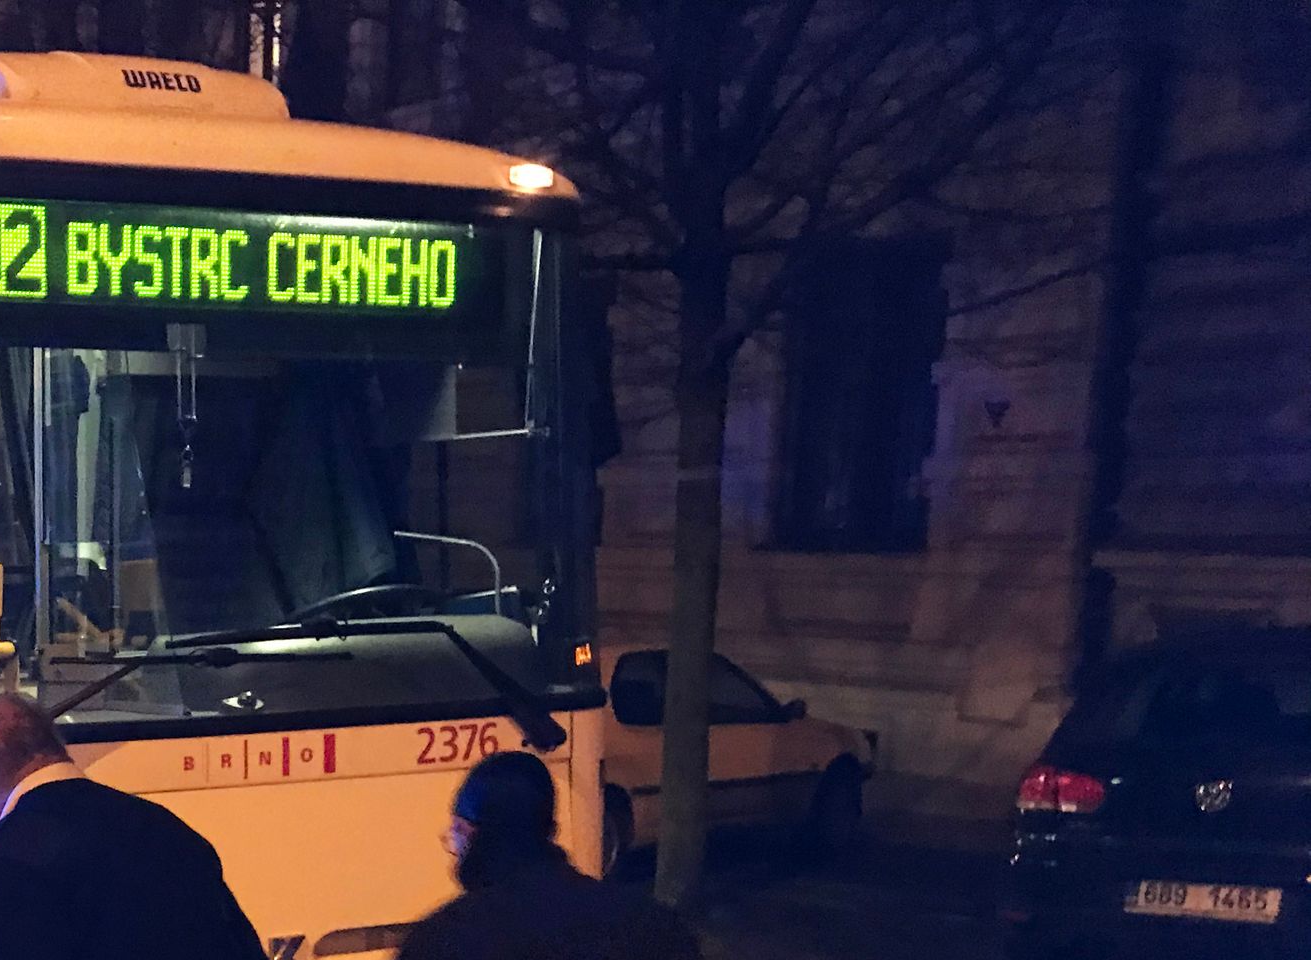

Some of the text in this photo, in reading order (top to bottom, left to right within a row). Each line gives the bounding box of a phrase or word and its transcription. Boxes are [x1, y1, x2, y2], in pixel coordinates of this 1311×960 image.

[121, 69, 201, 93] WAECO
[67, 221, 456, 308] BYSTRC CERNEHO
[417, 721, 499, 765] 2376
